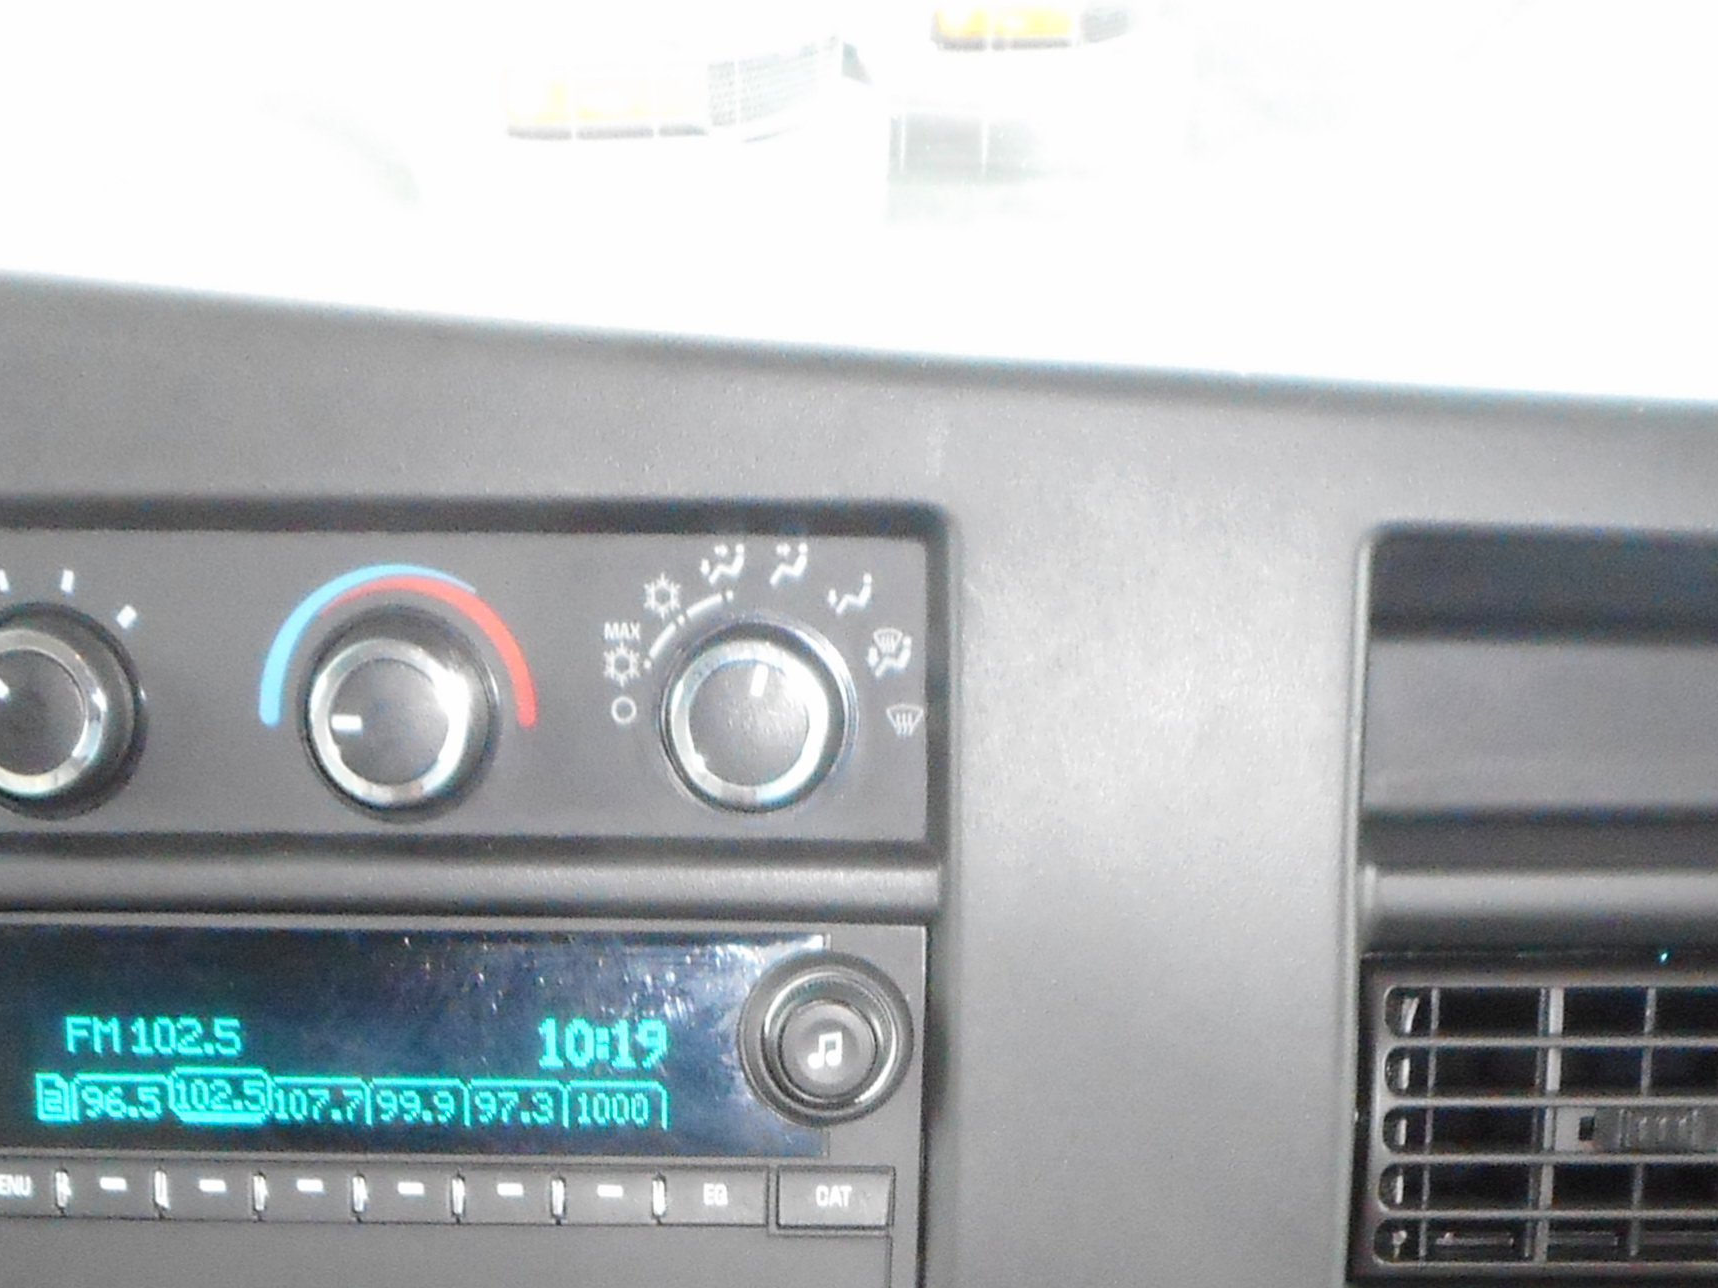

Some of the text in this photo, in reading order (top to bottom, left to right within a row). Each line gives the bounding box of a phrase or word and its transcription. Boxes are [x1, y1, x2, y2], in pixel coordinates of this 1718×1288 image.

[604, 621, 641, 641] MAX
[66, 1017, 243, 1057] FM 102.5
[538, 1017, 669, 1070] 10:19
[83, 1085, 161, 1120] 96.5
[174, 1080, 264, 1111] 102.5
[273, 1087, 365, 1123] 107.7
[376, 1092, 454, 1124] 99.9
[474, 1091, 554, 1125] 97.3
[577, 1091, 647, 1125] 1000
[703, 1183, 728, 1206] EQ
[815, 1186, 853, 1209] CAT
